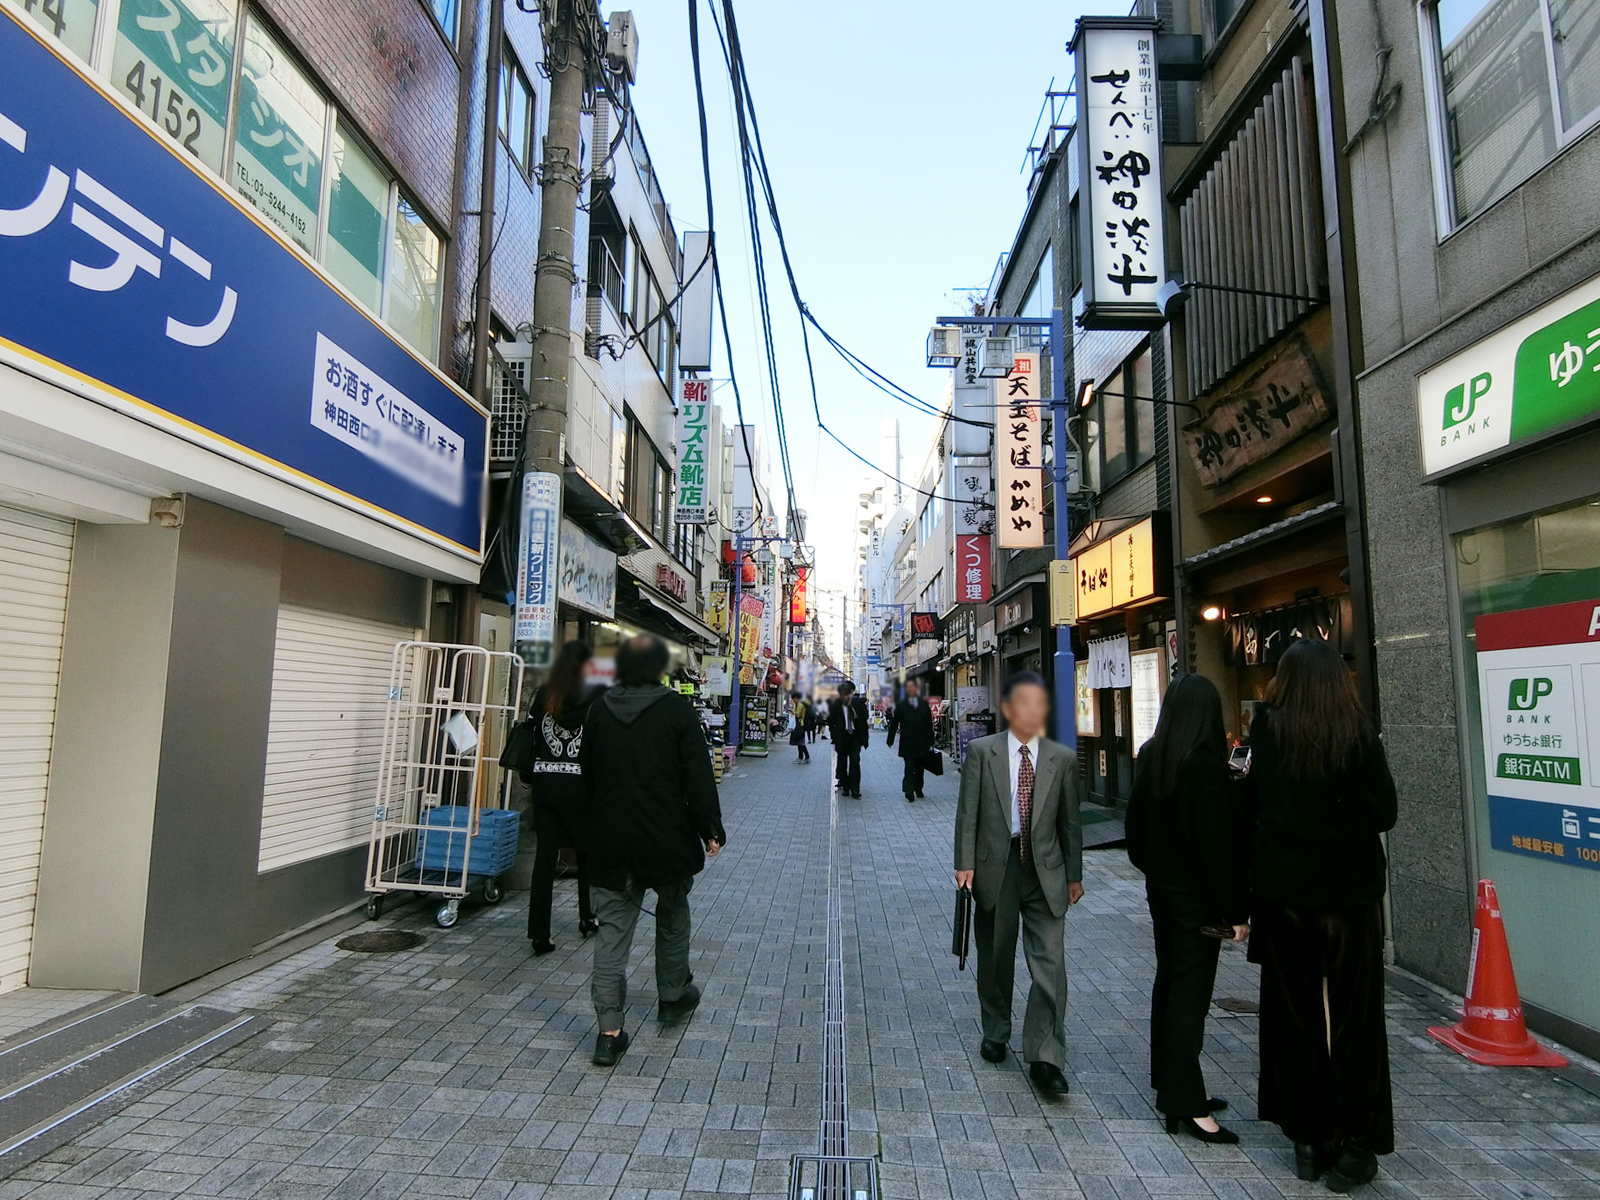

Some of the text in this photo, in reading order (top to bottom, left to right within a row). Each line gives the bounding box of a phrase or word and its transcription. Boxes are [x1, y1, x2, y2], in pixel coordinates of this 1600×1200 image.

[126, 60, 201, 158] 4152
[1442, 371, 1492, 431] JP
[1440, 416, 1490, 447] BANK
[1010, 479, 1032, 531] かめや
[965, 537, 982, 600] くつ修理
[1508, 678, 1553, 711] JP
[1506, 714, 1551, 724] BANK
[1503, 732, 1562, 749] ゆうちょ銀行
[1504, 756, 1571, 780] 銀行ATM
[1511, 834, 1564, 857] 地域最安値
